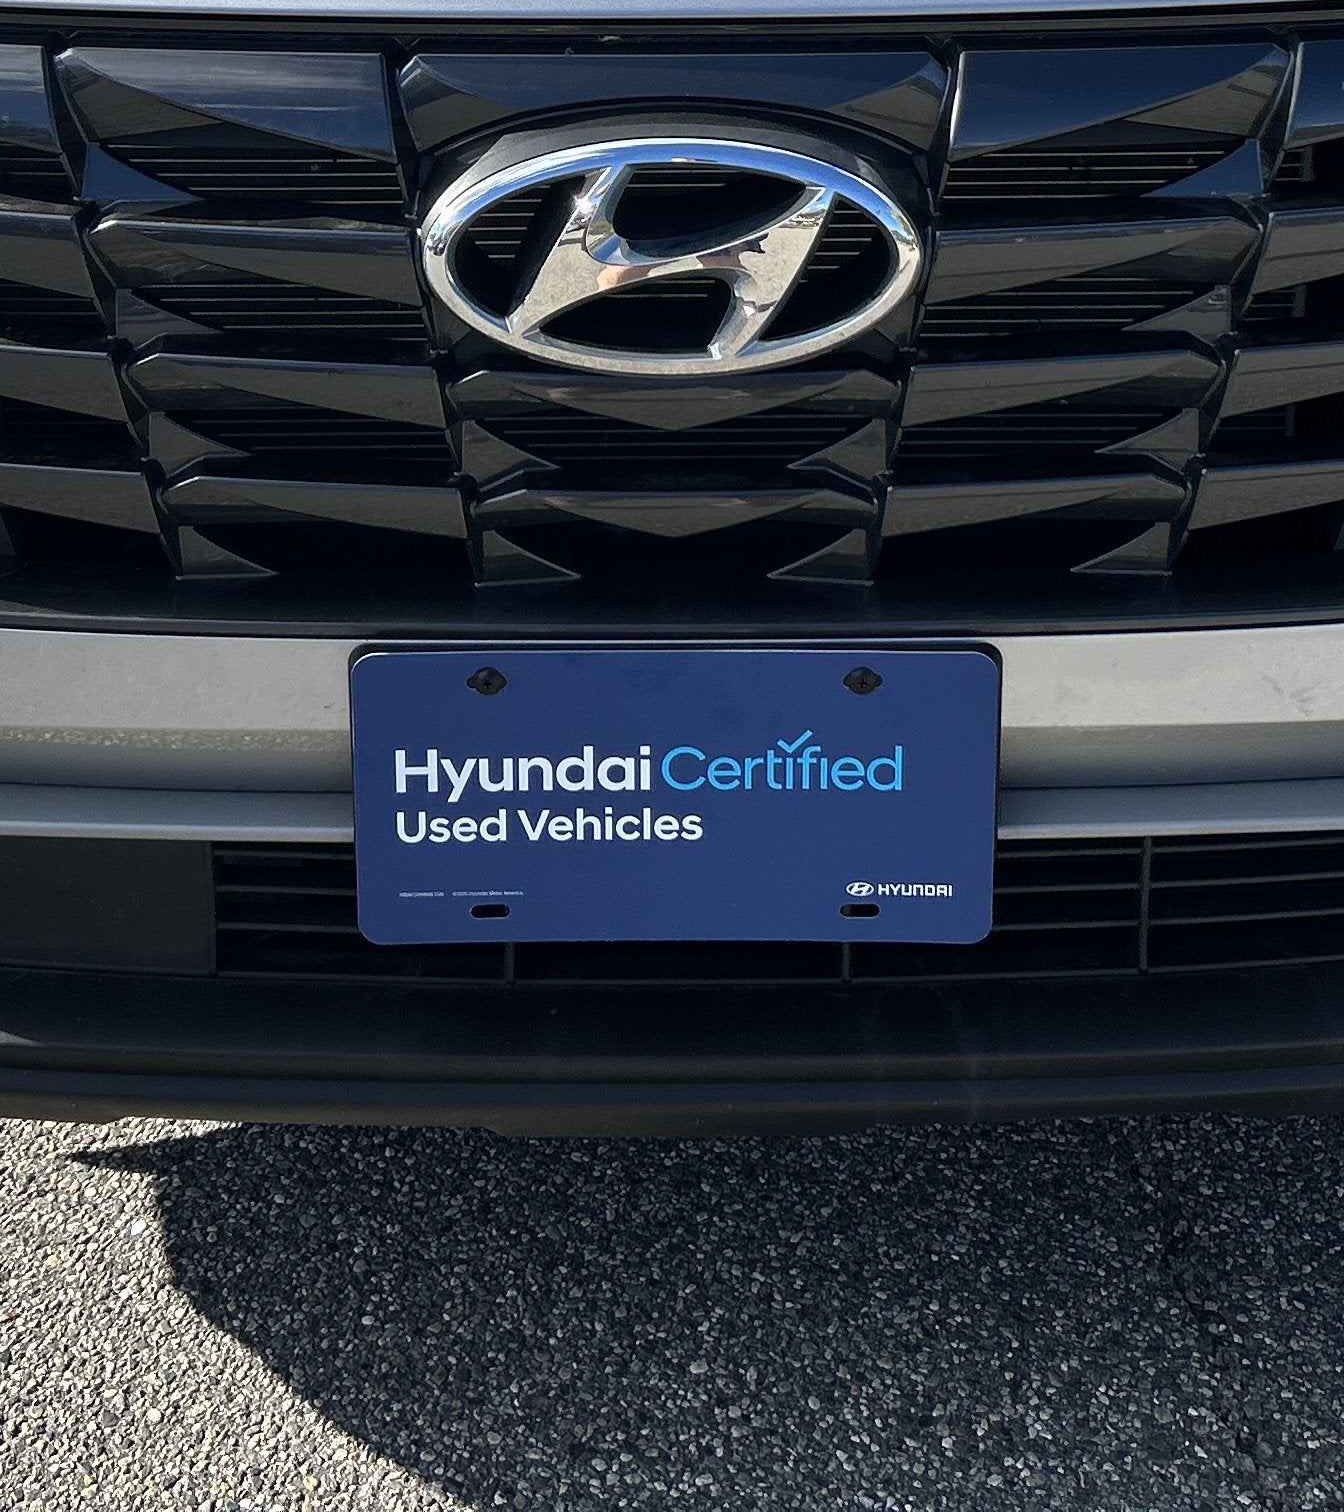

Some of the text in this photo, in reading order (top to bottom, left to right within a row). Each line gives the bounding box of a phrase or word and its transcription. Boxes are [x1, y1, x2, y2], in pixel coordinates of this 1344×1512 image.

[395, 730, 904, 802] Hyundai Certified
[396, 807, 703, 843] Used Vehicles
[878, 884, 953, 897] HYUNDAI
